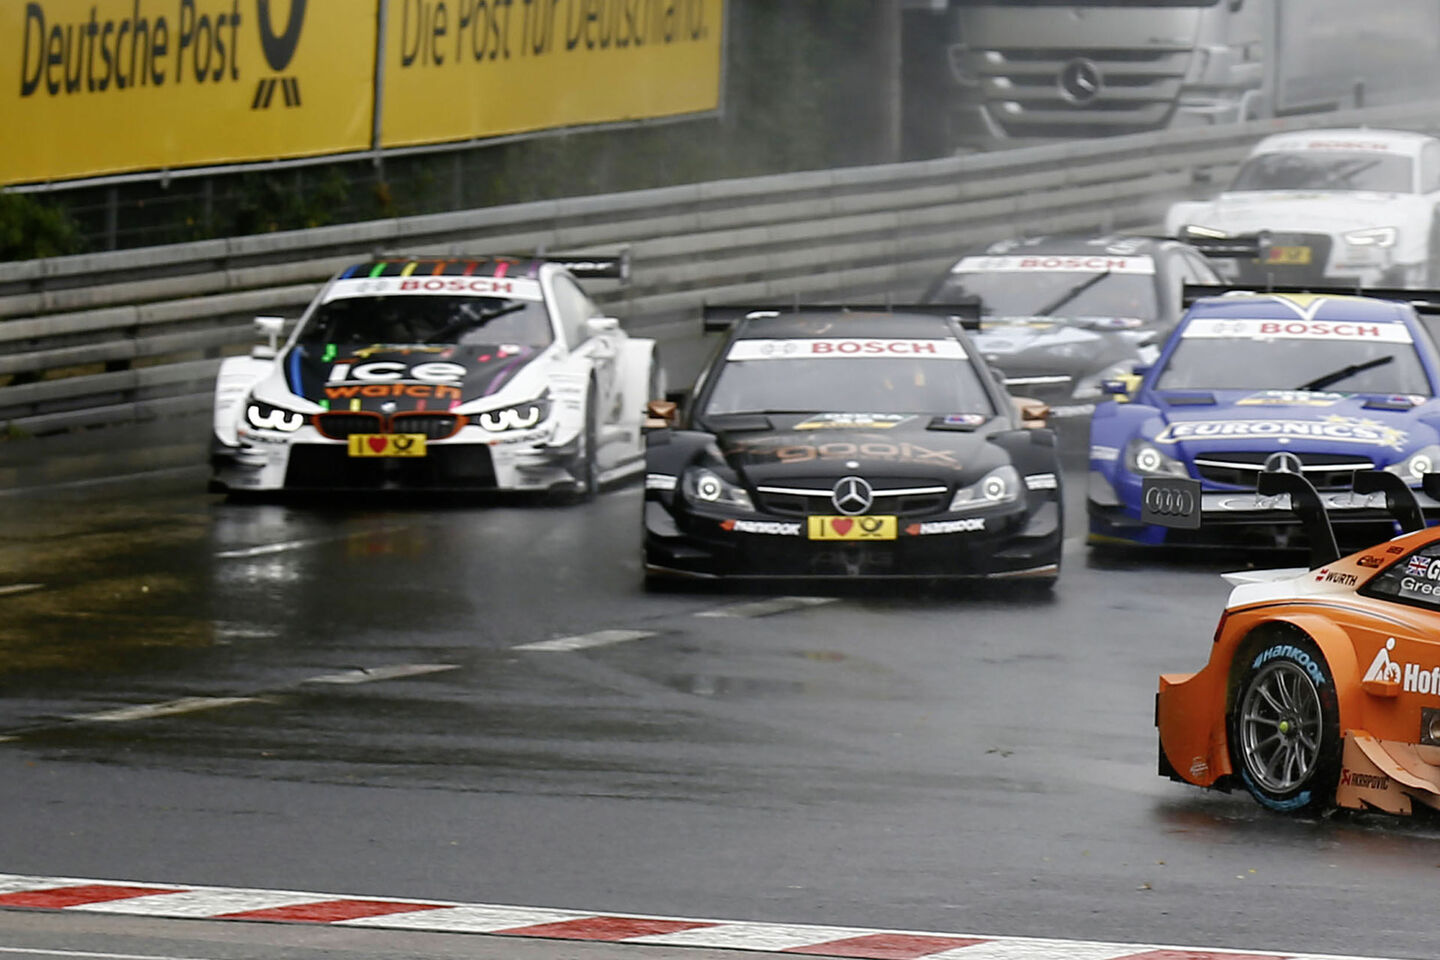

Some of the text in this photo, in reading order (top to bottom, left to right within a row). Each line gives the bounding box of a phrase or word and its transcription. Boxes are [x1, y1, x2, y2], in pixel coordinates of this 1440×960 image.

[1020, 258, 1126, 269] BOSCH
[399, 279, 513, 293] BOSCH
[1260, 323, 1380, 337] BOSCH
[811, 341, 936, 355] BOSCH
[328, 360, 467, 382] ice
[324, 383, 462, 399] watch
[1173, 421, 1379, 439] EURONICS
